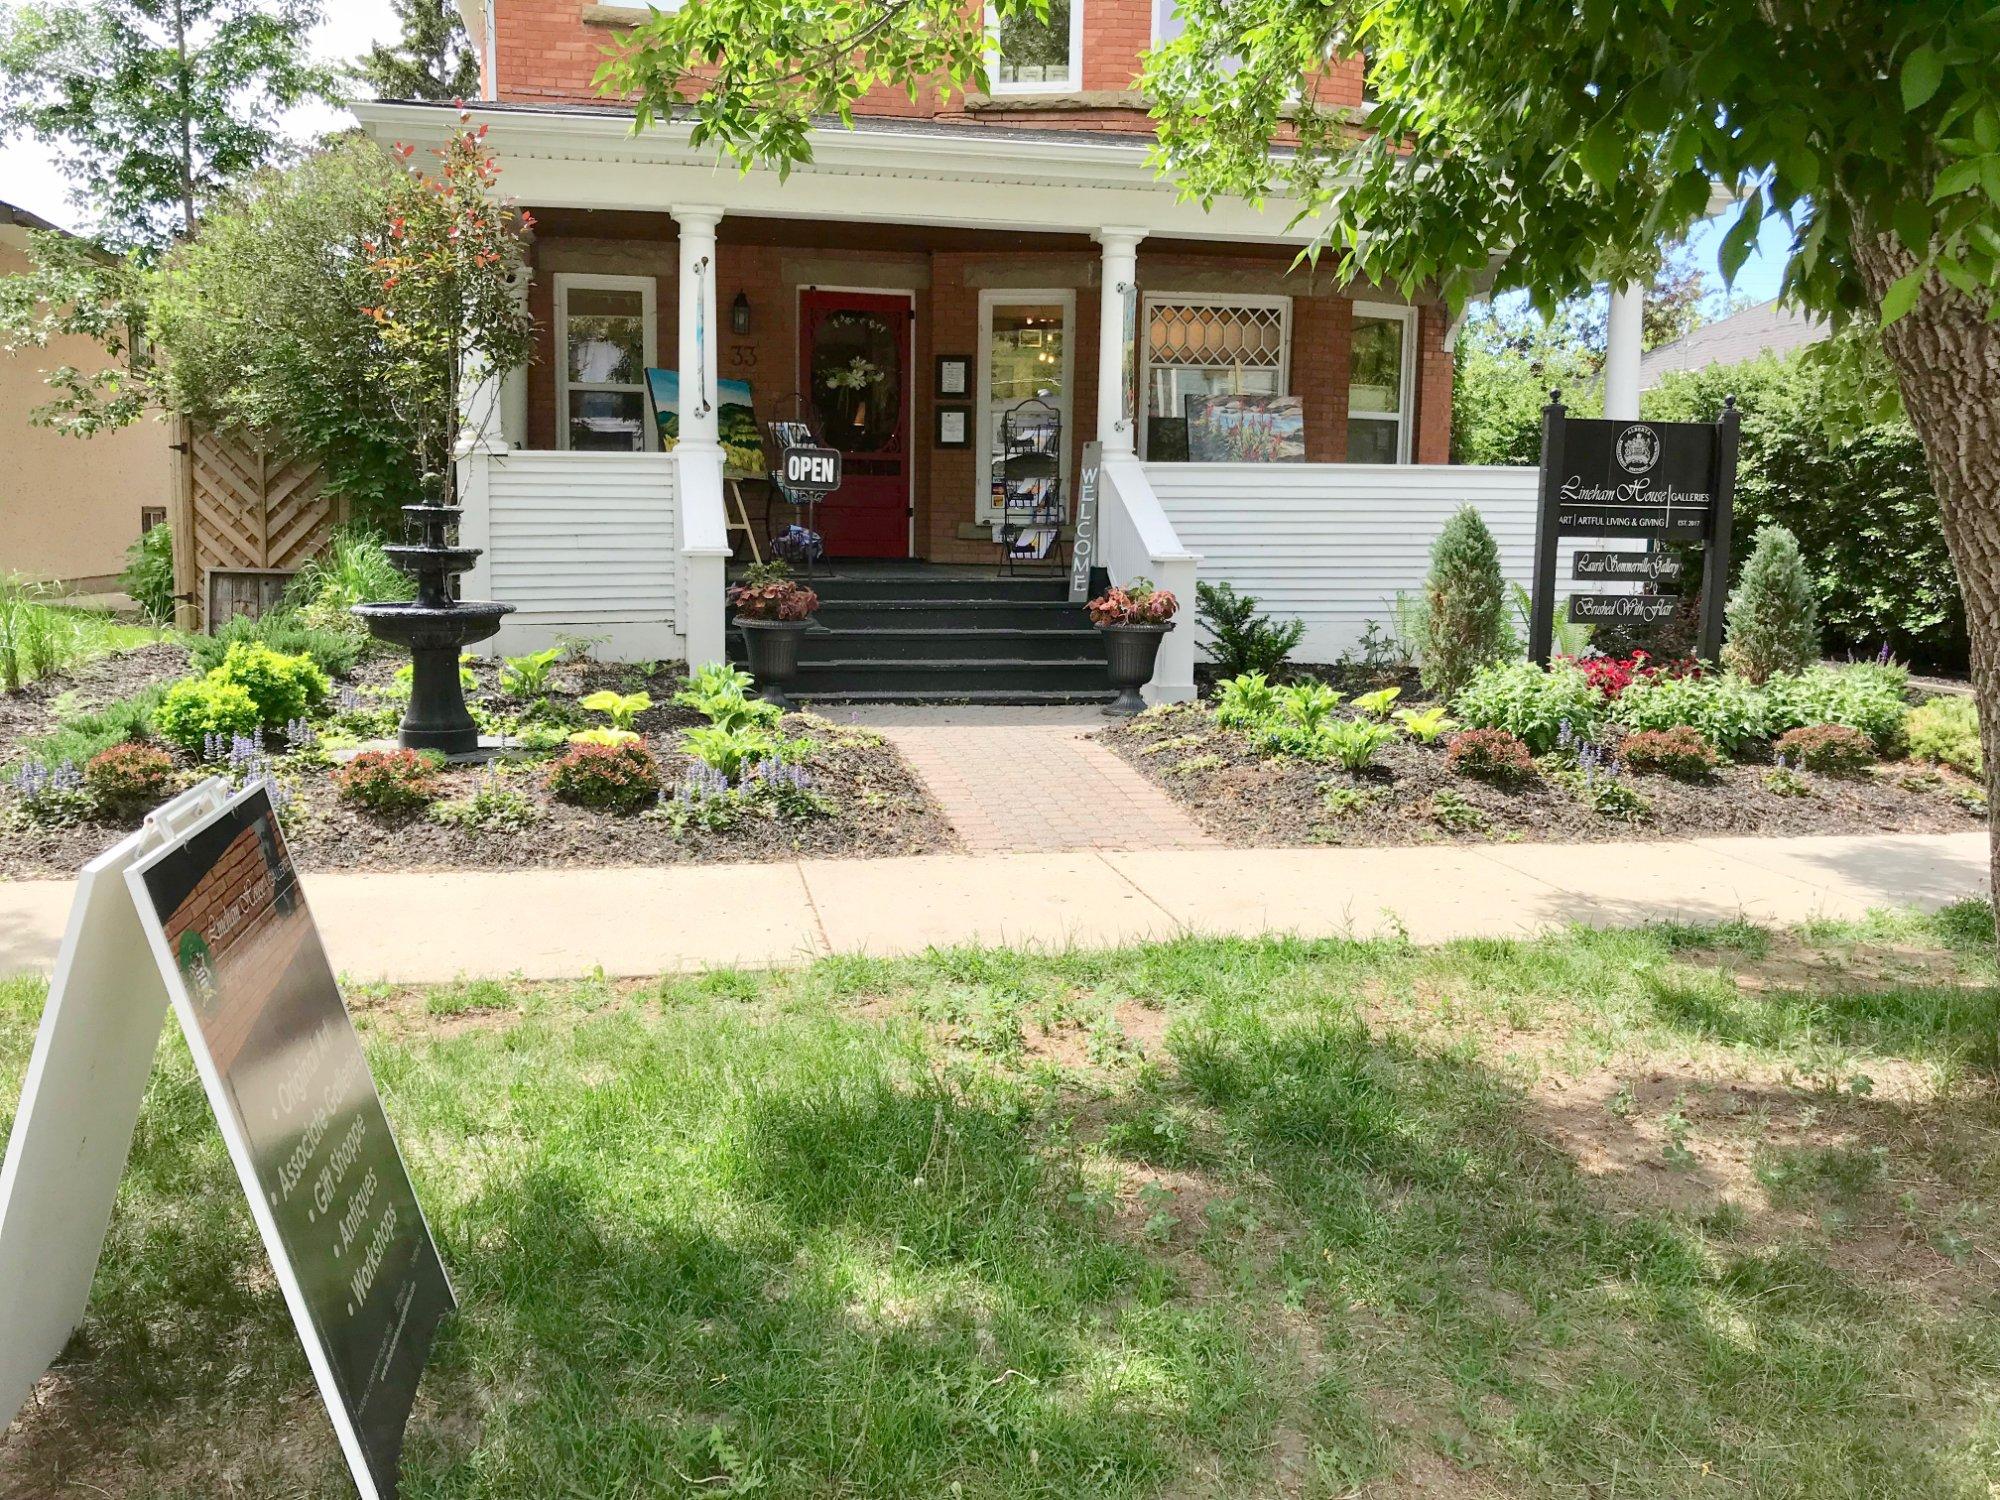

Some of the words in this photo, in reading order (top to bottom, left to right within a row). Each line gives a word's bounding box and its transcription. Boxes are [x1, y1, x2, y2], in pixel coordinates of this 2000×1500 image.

[731, 345, 757, 366] 33
[788, 456, 834, 483] OPEN
[1560, 475, 1615, 501] Lineham
[1616, 477, 1667, 502] House
[1671, 492, 1710, 502] GALLERIES
[1073, 467, 1098, 592] WELCOME
[1559, 516, 1572, 525] ART
[1578, 517, 1604, 526] ARTFUL
[1606, 518, 1630, 527] LIVING
[1631, 518, 1638, 526] &
[1639, 518, 1665, 527] GIVING
[1575, 597, 1616, 615] Brushed
[1616, 597, 1644, 616] With
[1643, 598, 1674, 622] Flair
[278, 1107, 329, 1201] Associate
[314, 1165, 336, 1214] Gift
[330, 1113, 366, 1183] Shoppe
[339, 1166, 377, 1253] Antiques
[351, 1201, 397, 1307] Workshops
